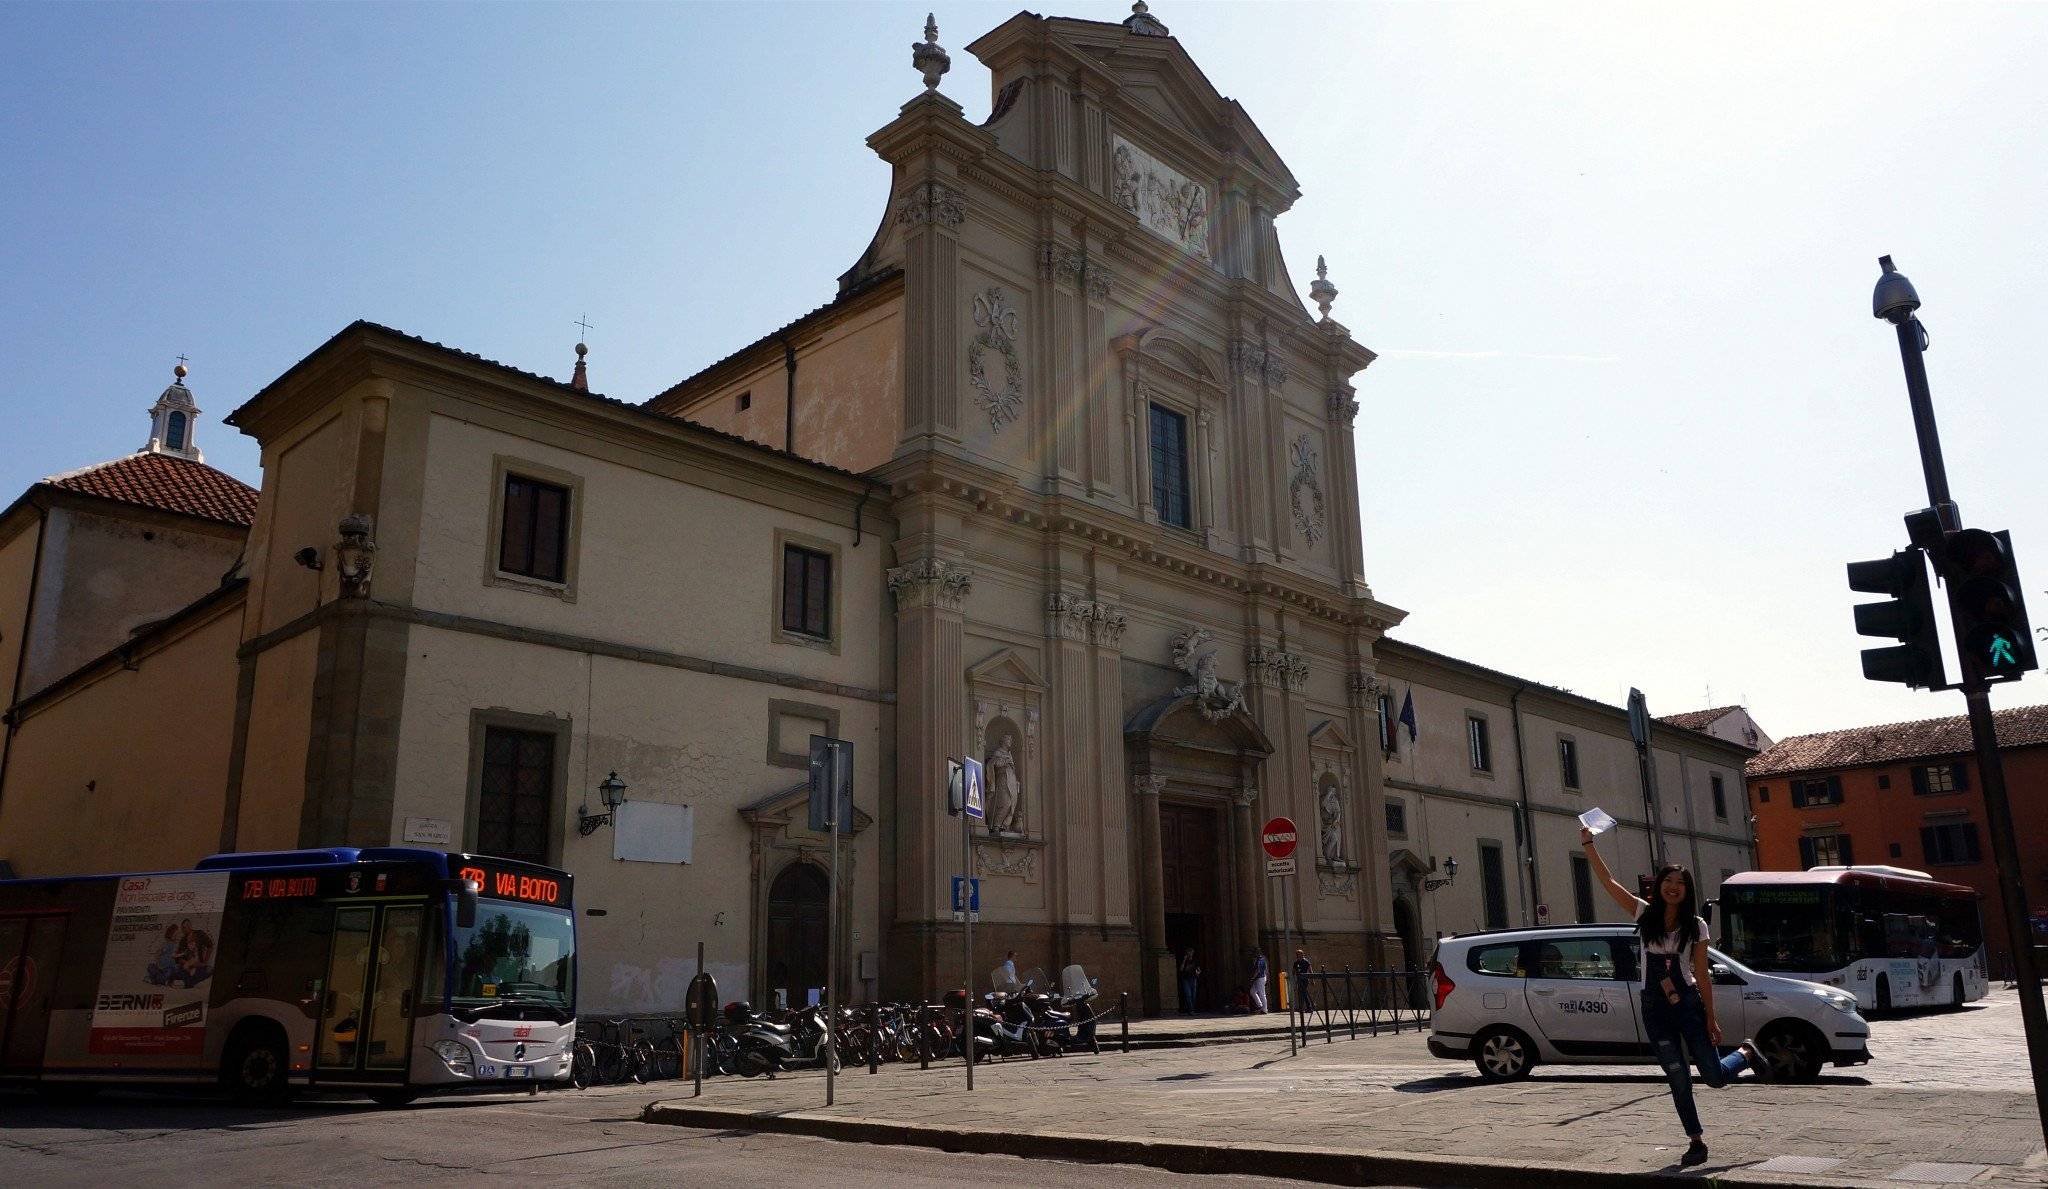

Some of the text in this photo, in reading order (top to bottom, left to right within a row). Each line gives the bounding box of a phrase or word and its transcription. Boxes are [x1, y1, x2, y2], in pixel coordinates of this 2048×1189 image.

[121, 878, 152, 890] Casa?
[496, 872, 516, 897] VIA
[519, 876, 559, 902] BOITO
[98, 994, 153, 1010] BERNI
[1578, 1000, 1608, 1014] 4390
